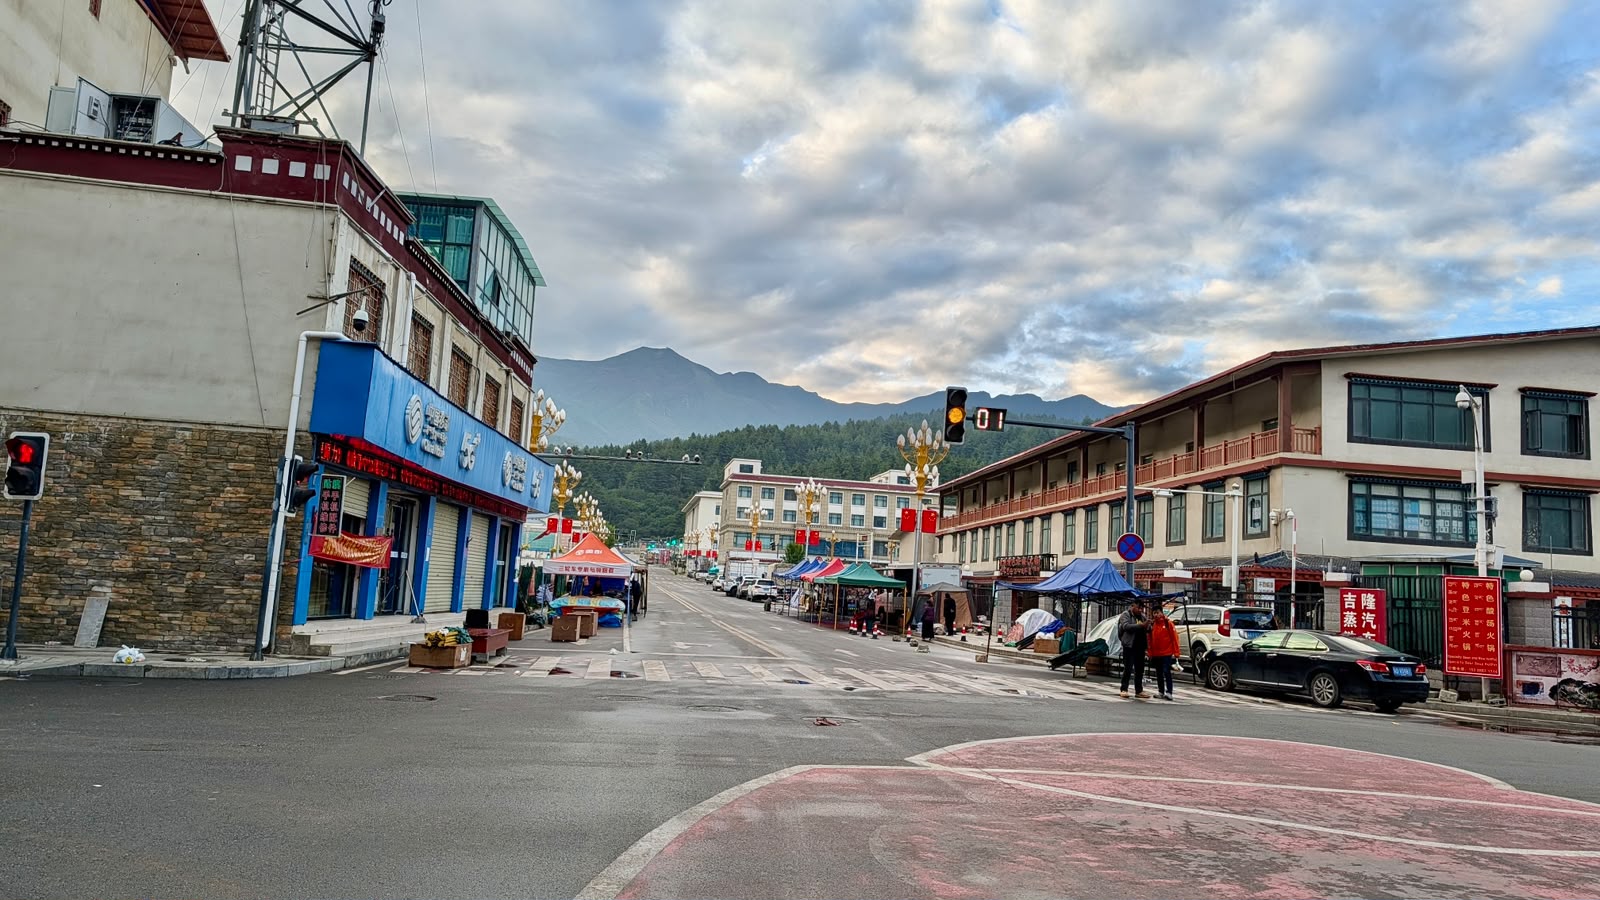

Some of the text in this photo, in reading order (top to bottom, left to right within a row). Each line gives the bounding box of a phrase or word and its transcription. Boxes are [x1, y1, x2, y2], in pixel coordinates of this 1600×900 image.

[976, 409, 1003, 430] 01
[1342, 592, 1376, 610] 吉隆
[1343, 611, 1377, 630] 蒸汽
